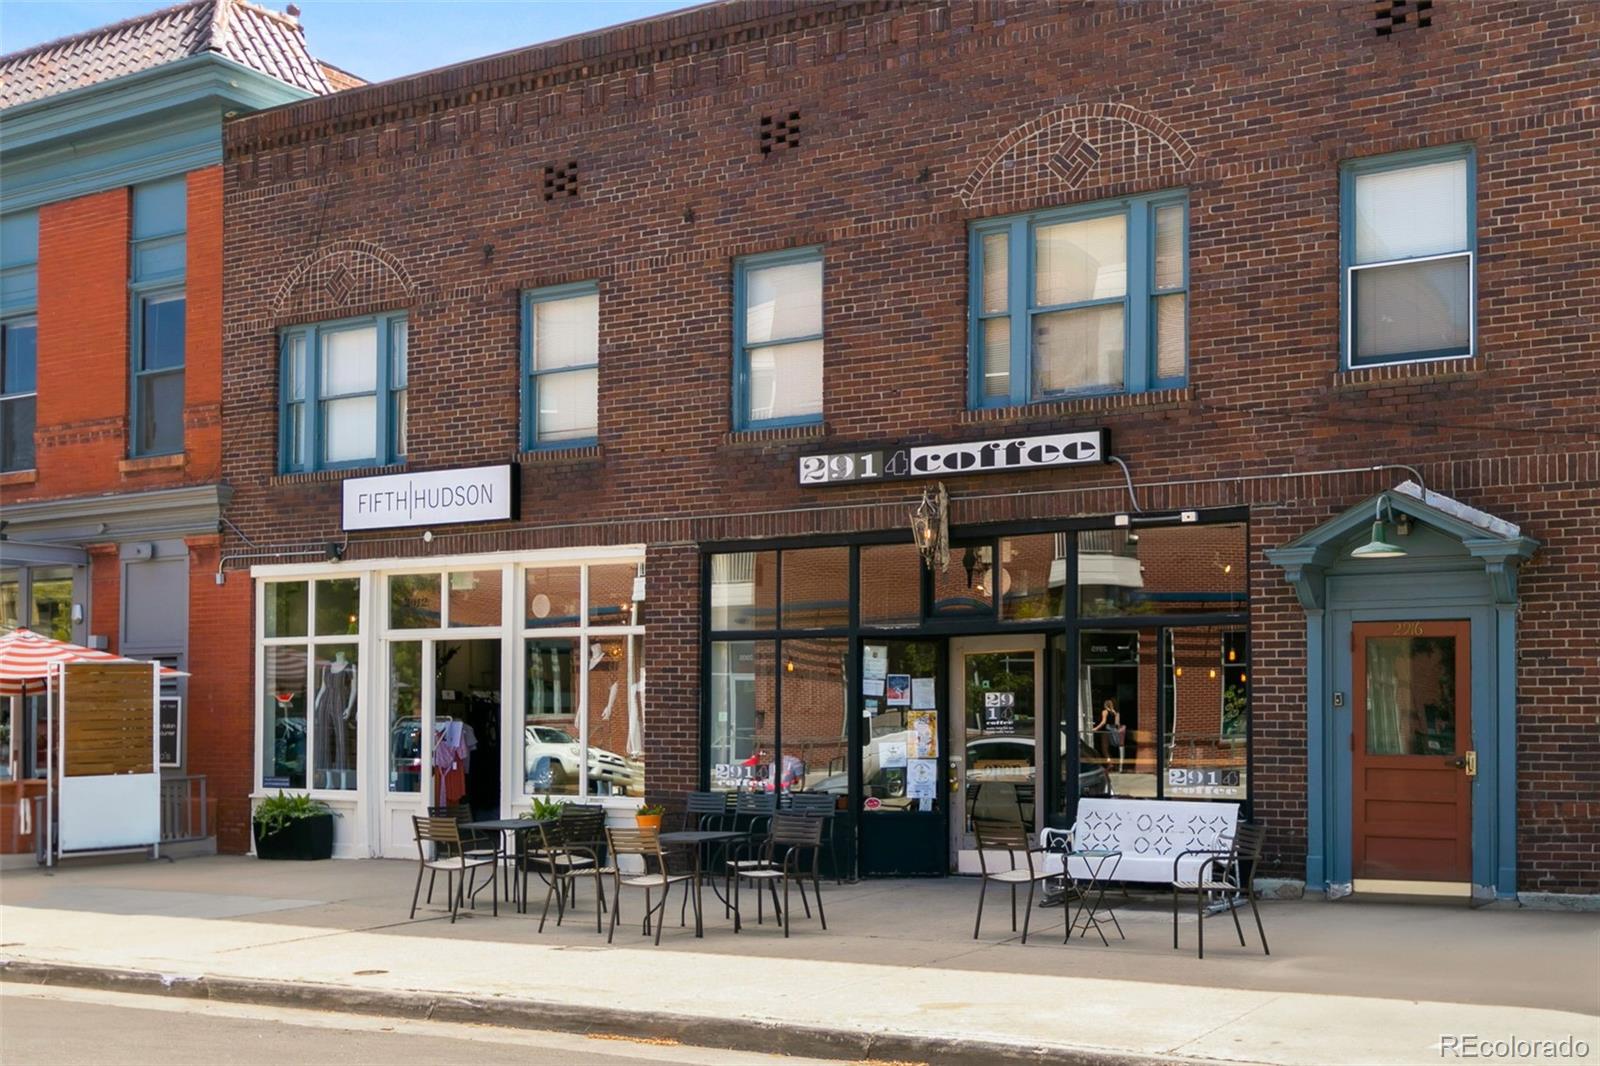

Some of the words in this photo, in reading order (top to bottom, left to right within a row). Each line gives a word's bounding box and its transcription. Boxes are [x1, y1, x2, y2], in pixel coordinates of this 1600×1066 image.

[803, 449, 910, 482] 2914
[914, 439, 1097, 470] coffee
[358, 490, 407, 514] FIFTH
[414, 483, 494, 510] HUDSON
[985, 692, 1015, 706] 29
[716, 764, 769, 779] 2914
[1170, 769, 1240, 785] 2914
